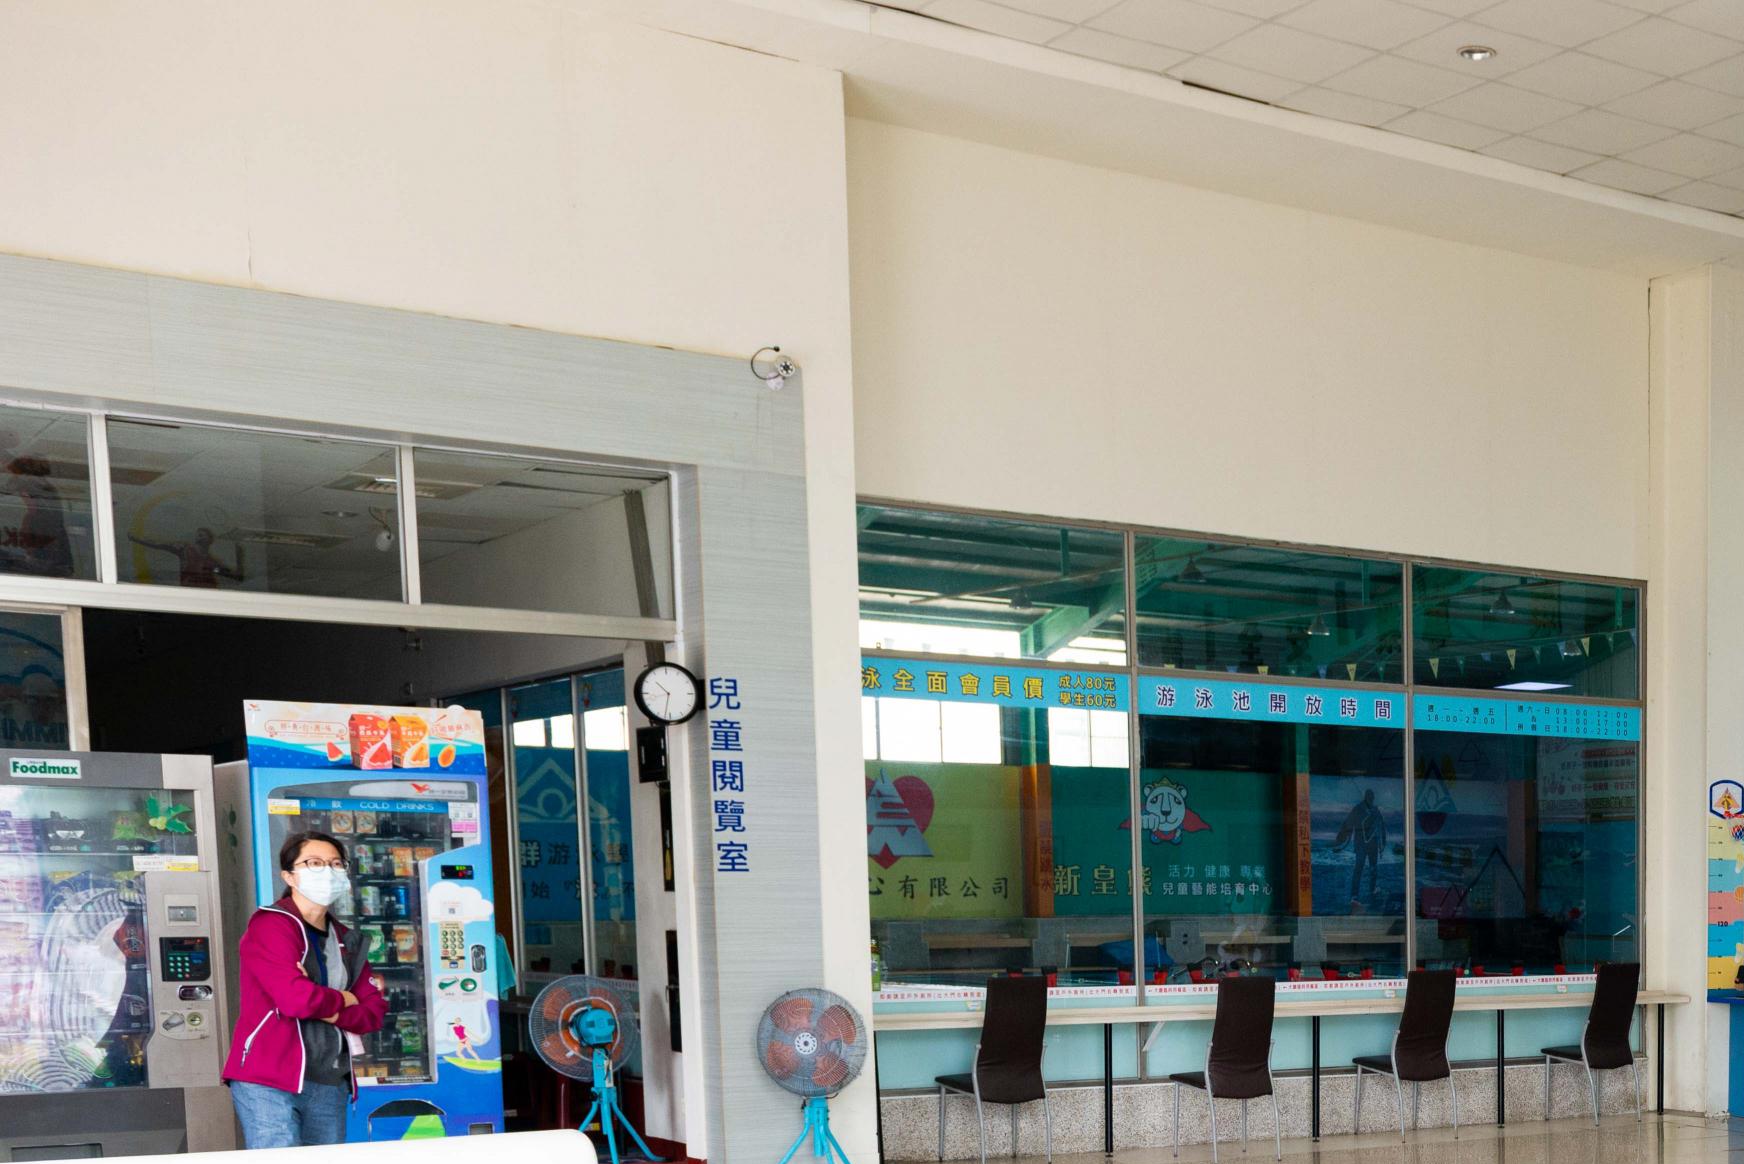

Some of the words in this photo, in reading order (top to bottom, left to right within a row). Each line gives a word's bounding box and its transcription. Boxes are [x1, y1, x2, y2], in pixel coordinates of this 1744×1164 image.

[1058, 674, 1116, 691] 成人80元
[1058, 692, 1116, 708] 學生60元
[1157, 685, 1391, 719] 游泳池開放時間
[12, 761, 78, 775] Foodmax
[709, 677, 750, 873] 兒童閱覽室
[360, 801, 389, 810] COLD
[396, 802, 434, 811] DRINKS
